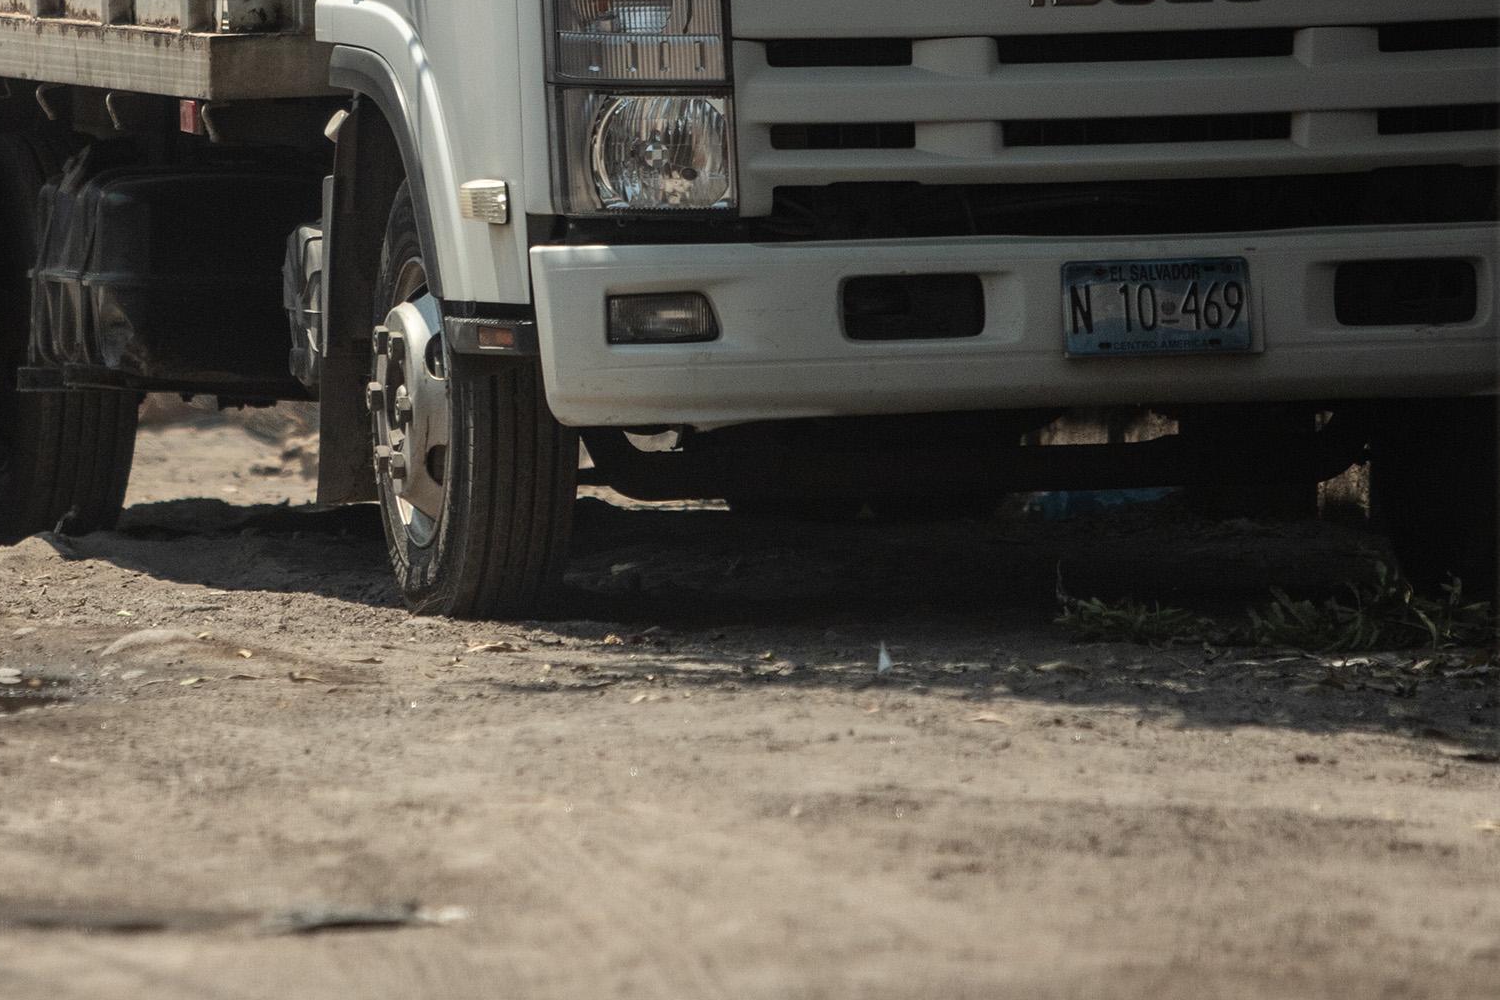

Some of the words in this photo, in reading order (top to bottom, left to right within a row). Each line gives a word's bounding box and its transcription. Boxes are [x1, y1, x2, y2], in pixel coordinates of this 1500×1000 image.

[1110, 265, 1130, 282] EL
[1130, 263, 1201, 281] SALVADOR
[1070, 284, 1093, 334] N
